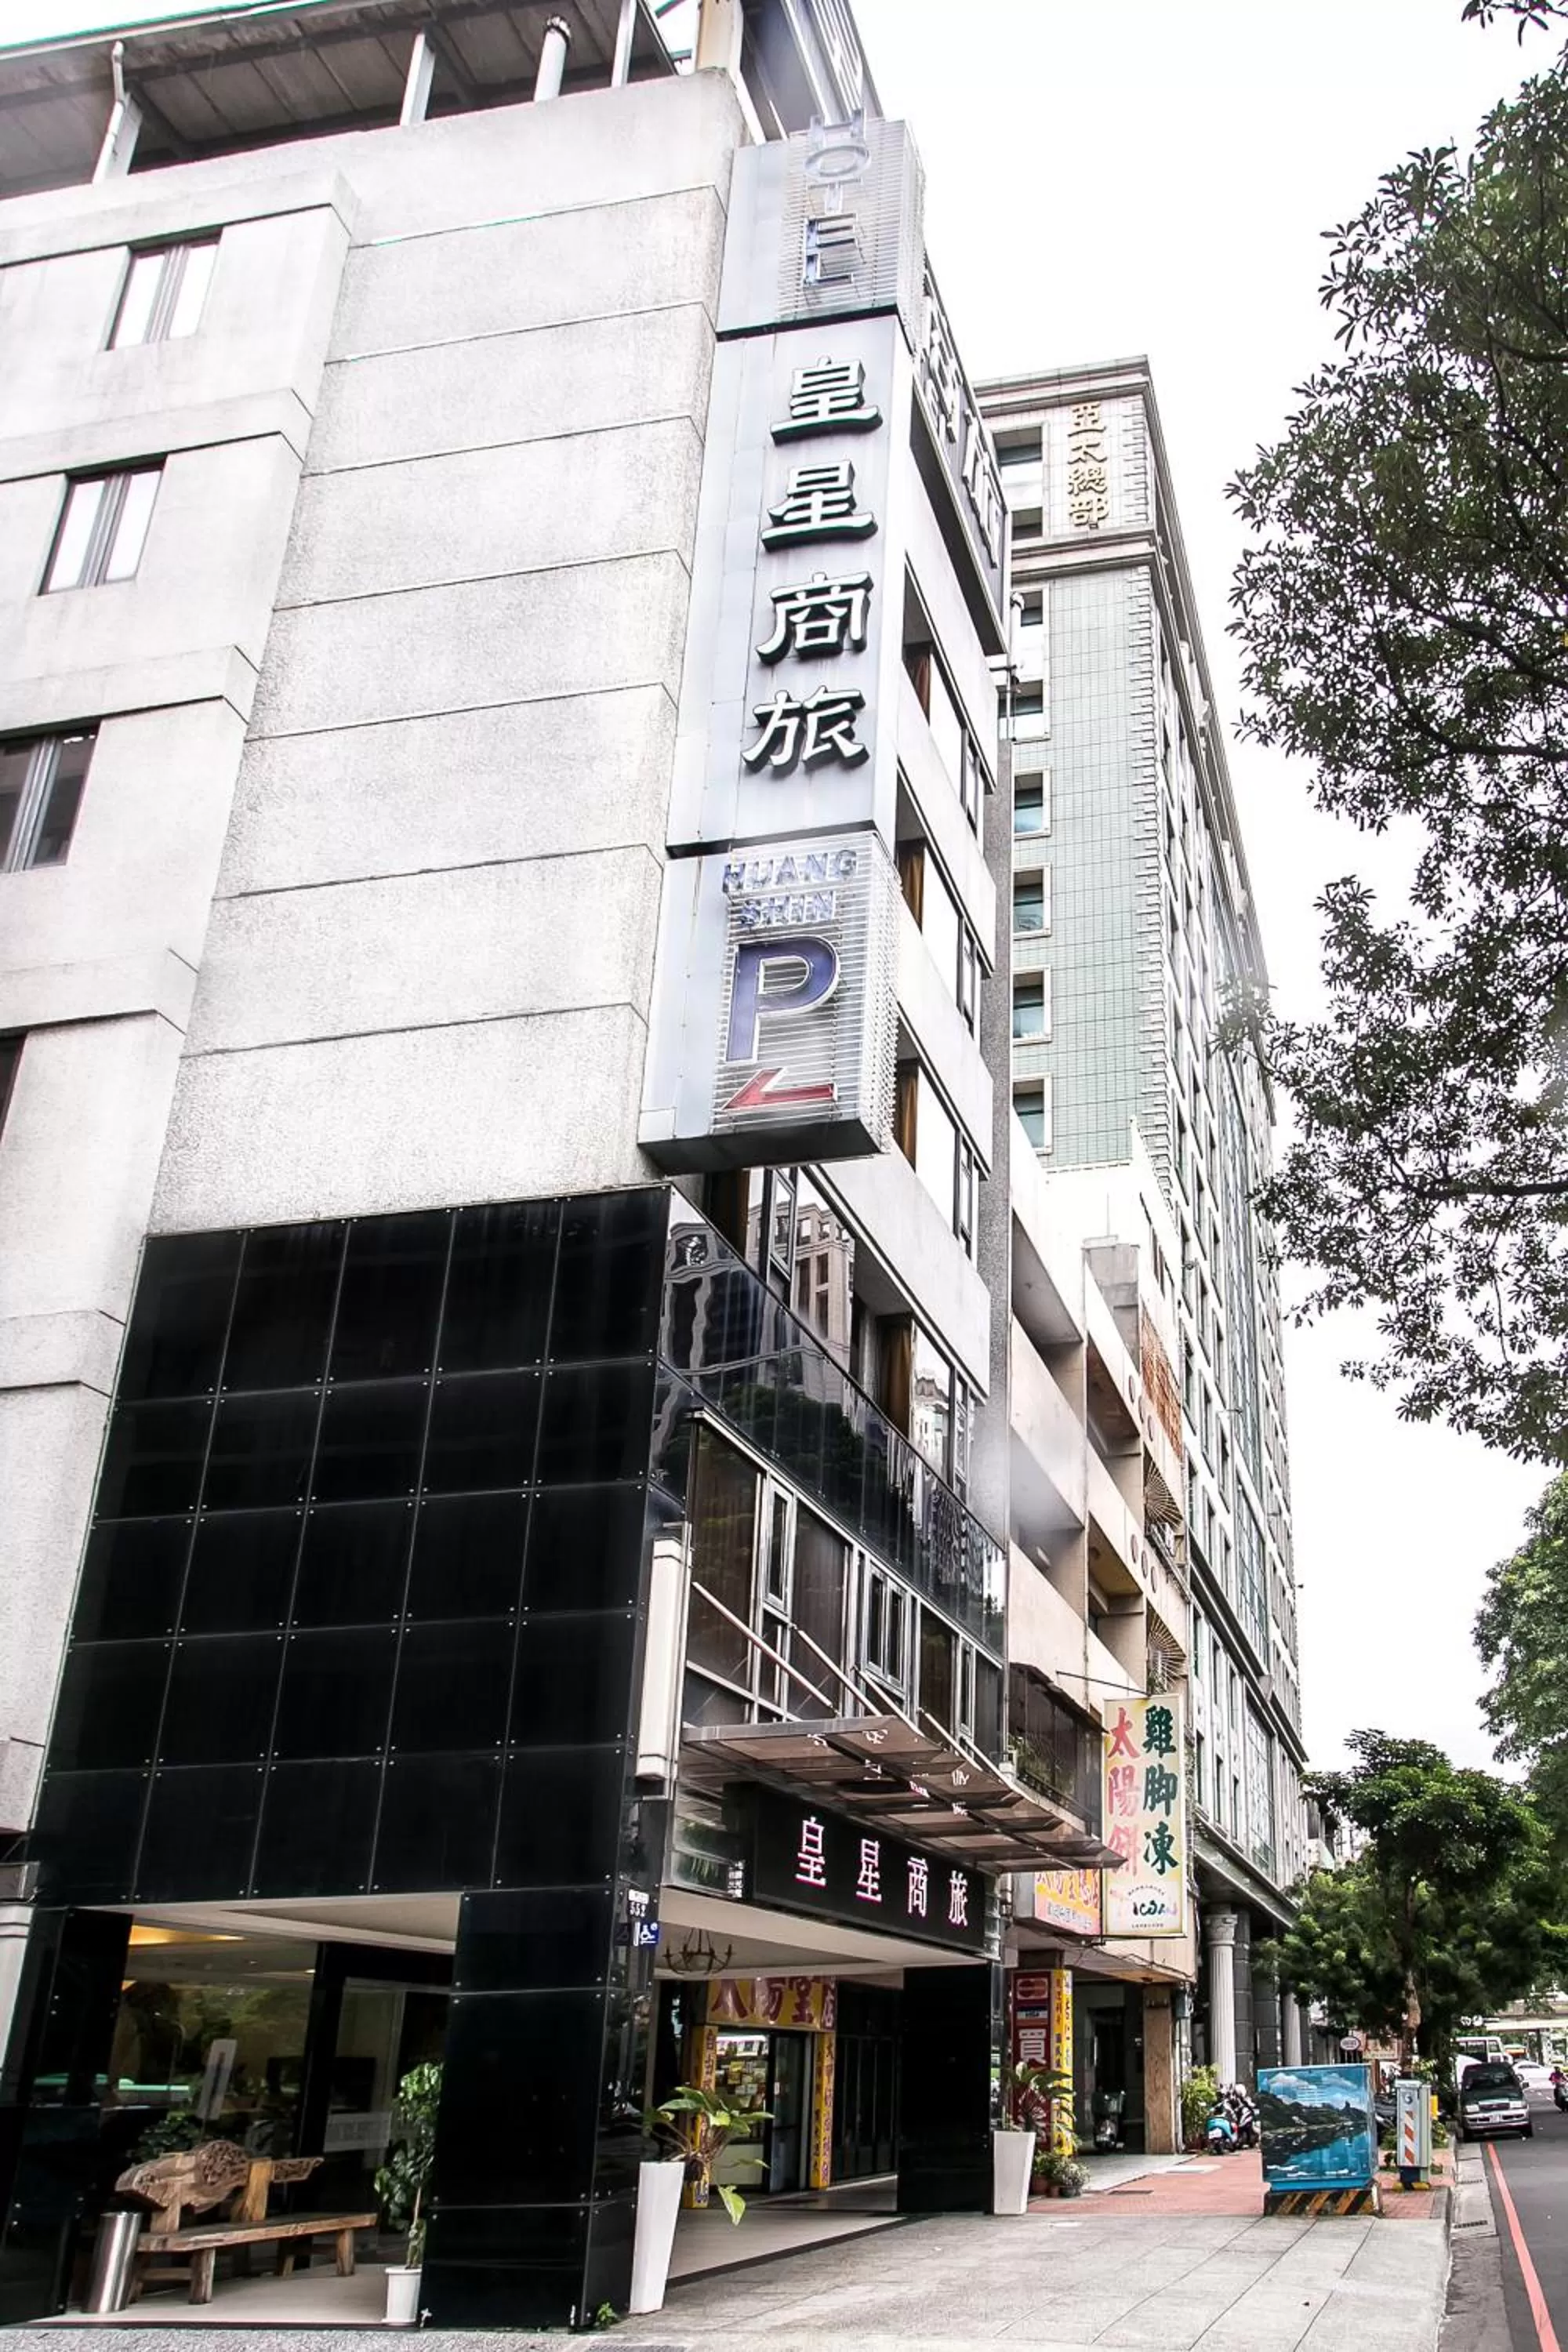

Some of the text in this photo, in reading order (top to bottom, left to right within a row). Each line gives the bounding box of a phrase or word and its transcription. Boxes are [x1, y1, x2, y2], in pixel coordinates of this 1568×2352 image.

[801, 107, 872, 288] HOTEL
[742, 355, 883, 772] 皇星商旅
[722, 848, 858, 895] HUANG
[794, 1816, 969, 1928] 皇星商旅
